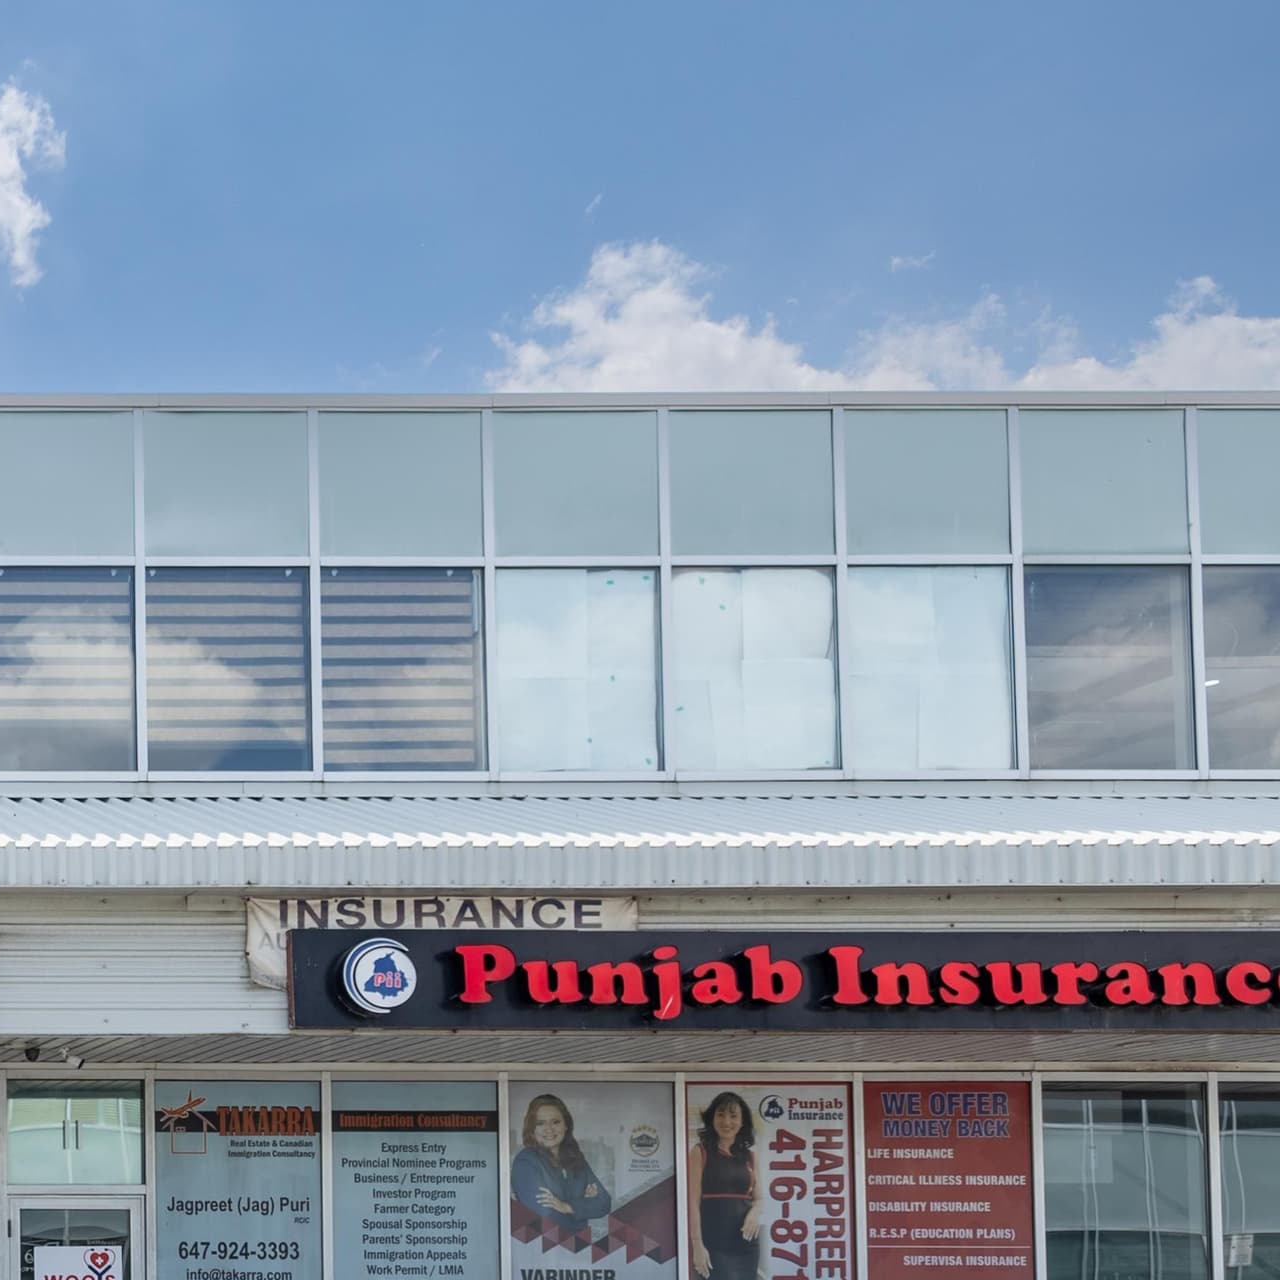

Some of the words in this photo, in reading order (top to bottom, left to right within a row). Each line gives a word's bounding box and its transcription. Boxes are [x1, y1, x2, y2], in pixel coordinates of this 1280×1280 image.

[279, 899, 603, 929] INSURANCE
[454, 945, 803, 1020] Punjab
[828, 945, 1280, 1005] Insuranc
[788, 1098, 843, 1111] Punjab
[881, 1091, 921, 1117] WE
[928, 1091, 1009, 1117] OFFER
[216, 1105, 316, 1136] TAKARRA
[340, 1113, 414, 1128] Immigration
[417, 1113, 488, 1128] Consultancy
[788, 1110, 844, 1120] Insurance
[882, 1119, 951, 1138] MONEY
[956, 1119, 1010, 1138] BACK
[230, 1140, 247, 1148] Real
[247, 1140, 270, 1148] Estate
[279, 1140, 313, 1148] Canadian
[381, 1142, 419, 1155] Express
[421, 1142, 446, 1155] Entry
[228, 1150, 274, 1159] Immigration
[274, 1150, 315, 1159] Consultancy
[867, 1148, 890, 1159] LIFE
[893, 1148, 954, 1159] INSURANCE
[341, 1158, 389, 1168] Provincial
[392, 1158, 437, 1168] Nominee
[439, 1158, 487, 1170] Programs
[354, 1173, 399, 1184] Business
[400, 1173, 407, 1185] /
[410, 1173, 475, 1186] Entrepreneur
[868, 1175, 916, 1185] CRITICAL
[919, 1175, 962, 1185] ILLNESS
[965, 1175, 1027, 1185] INSURANCE
[372, 1188, 412, 1199] Investor
[414, 1188, 456, 1201] Program
[167, 1196, 232, 1215] Jagpreet
[237, 1196, 275, 1215] (Jag)
[279, 1197, 310, 1212] Puri
[374, 1203, 409, 1214] Farmer
[411, 1203, 455, 1216] Category
[869, 1201, 927, 1212] DISABILITY
[930, 1201, 991, 1212] INSURANCE
[362, 1219, 403, 1231] Spousal
[405, 1219, 467, 1231] Sponsorship
[405, 1234, 468, 1247] Sponsorship
[869, 1228, 907, 1238] R.E.S.P
[910, 1228, 973, 1240] (EDUCATION
[976, 1228, 1016, 1240] PLANS)
[178, 1241, 300, 1260] 647-924-3393
[364, 1250, 424, 1262] Immigration
[425, 1250, 467, 1262] Appeals
[903, 1255, 963, 1266] SUPERVISA
[966, 1255, 1027, 1266] INSURANCE
[367, 1265, 393, 1276] Work
[394, 1265, 428, 1276] Permit
[429, 1265, 435, 1277] /
[439, 1265, 464, 1275] LMIA
